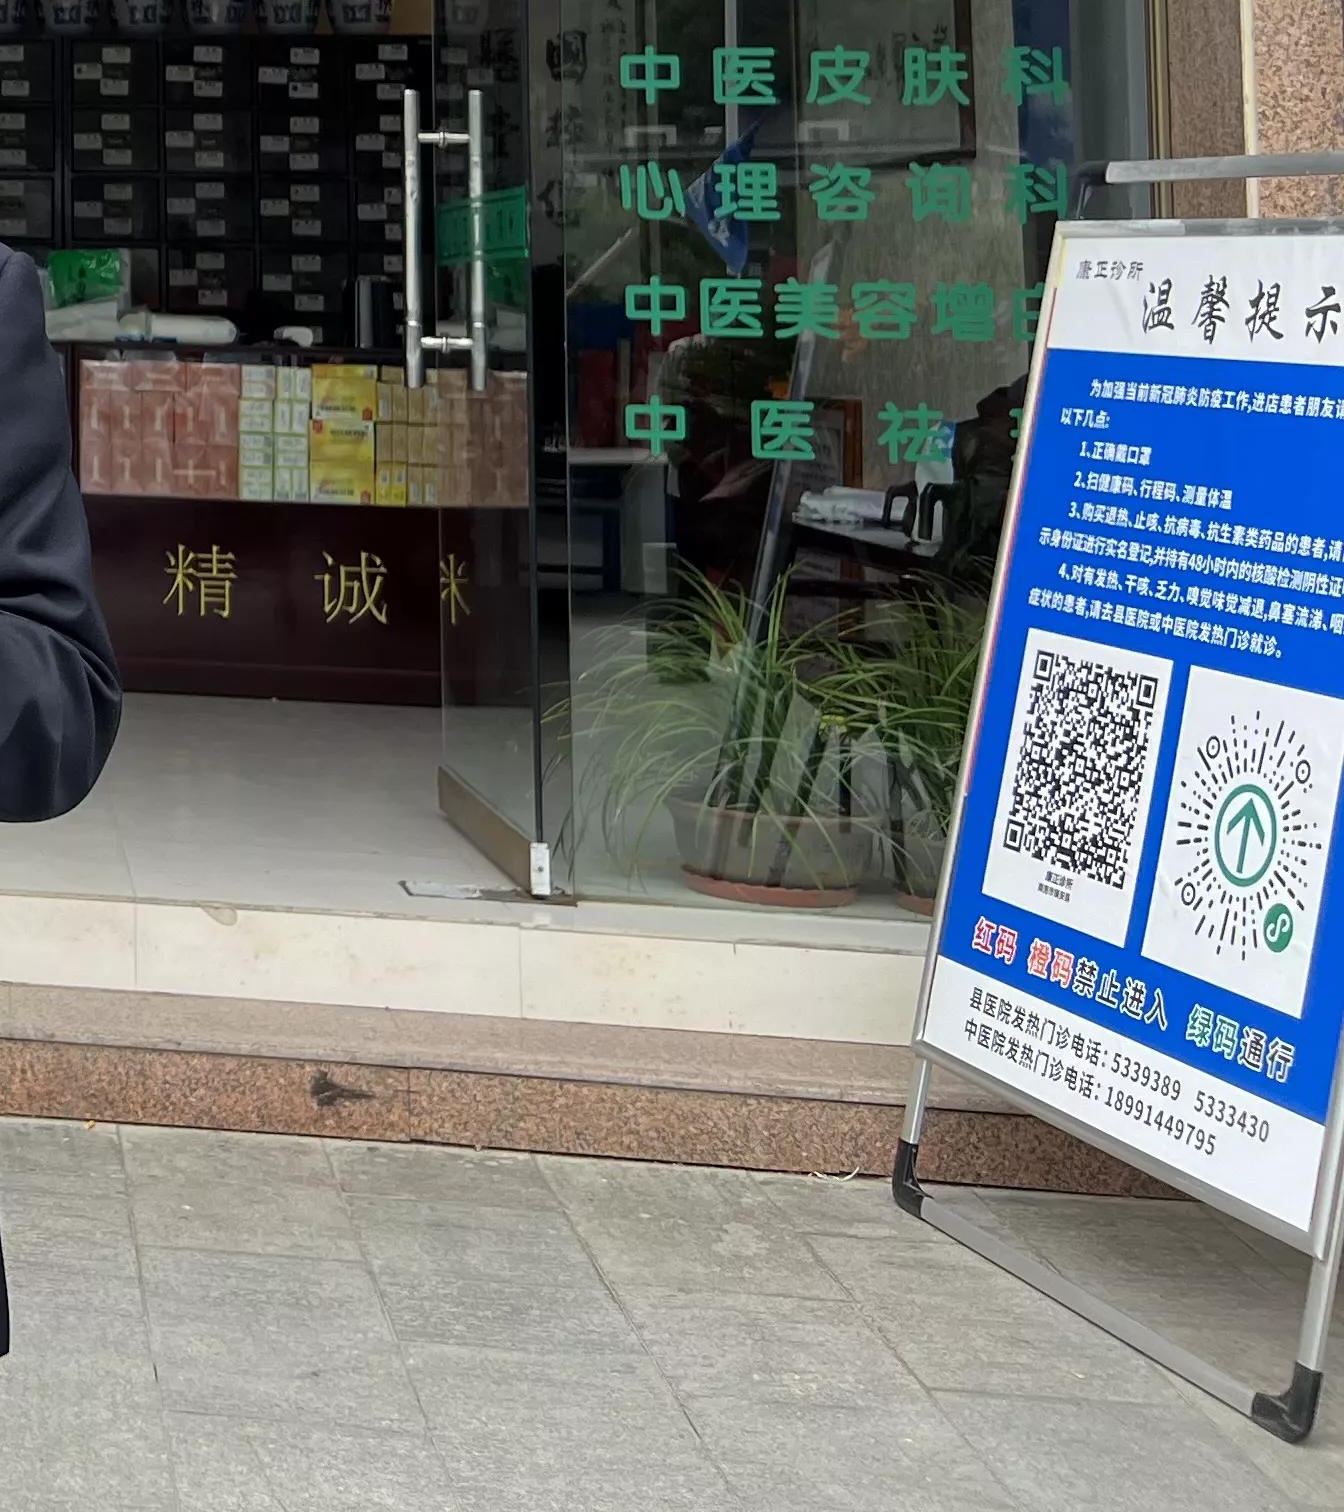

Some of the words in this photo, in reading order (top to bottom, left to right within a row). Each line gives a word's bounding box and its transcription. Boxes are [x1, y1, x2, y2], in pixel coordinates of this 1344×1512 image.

[618, 44, 1069, 107] 中医皮肤科
[621, 159, 1069, 225] 心理咨询科
[1075, 259, 1144, 282] 康正诊所
[1141, 274, 1342, 345] 温馨提示
[624, 395, 1028, 466] 中医祛
[1038, 526, 1344, 598] 示身份证进行实名登记,并持有48小时内的核酸检测阴性证
[1068, 500, 1344, 563] 3、购买退热、止咳、抗病毒、抗生素类药品的患者,请
[162, 543, 389, 626] 精诚
[972, 915, 1018, 965] 红码
[1027, 938, 1169, 1031] 橙码禁止进入
[1185, 1003, 1297, 1084] 绿码通行
[1193, 1090, 1270, 1144] 5333430
